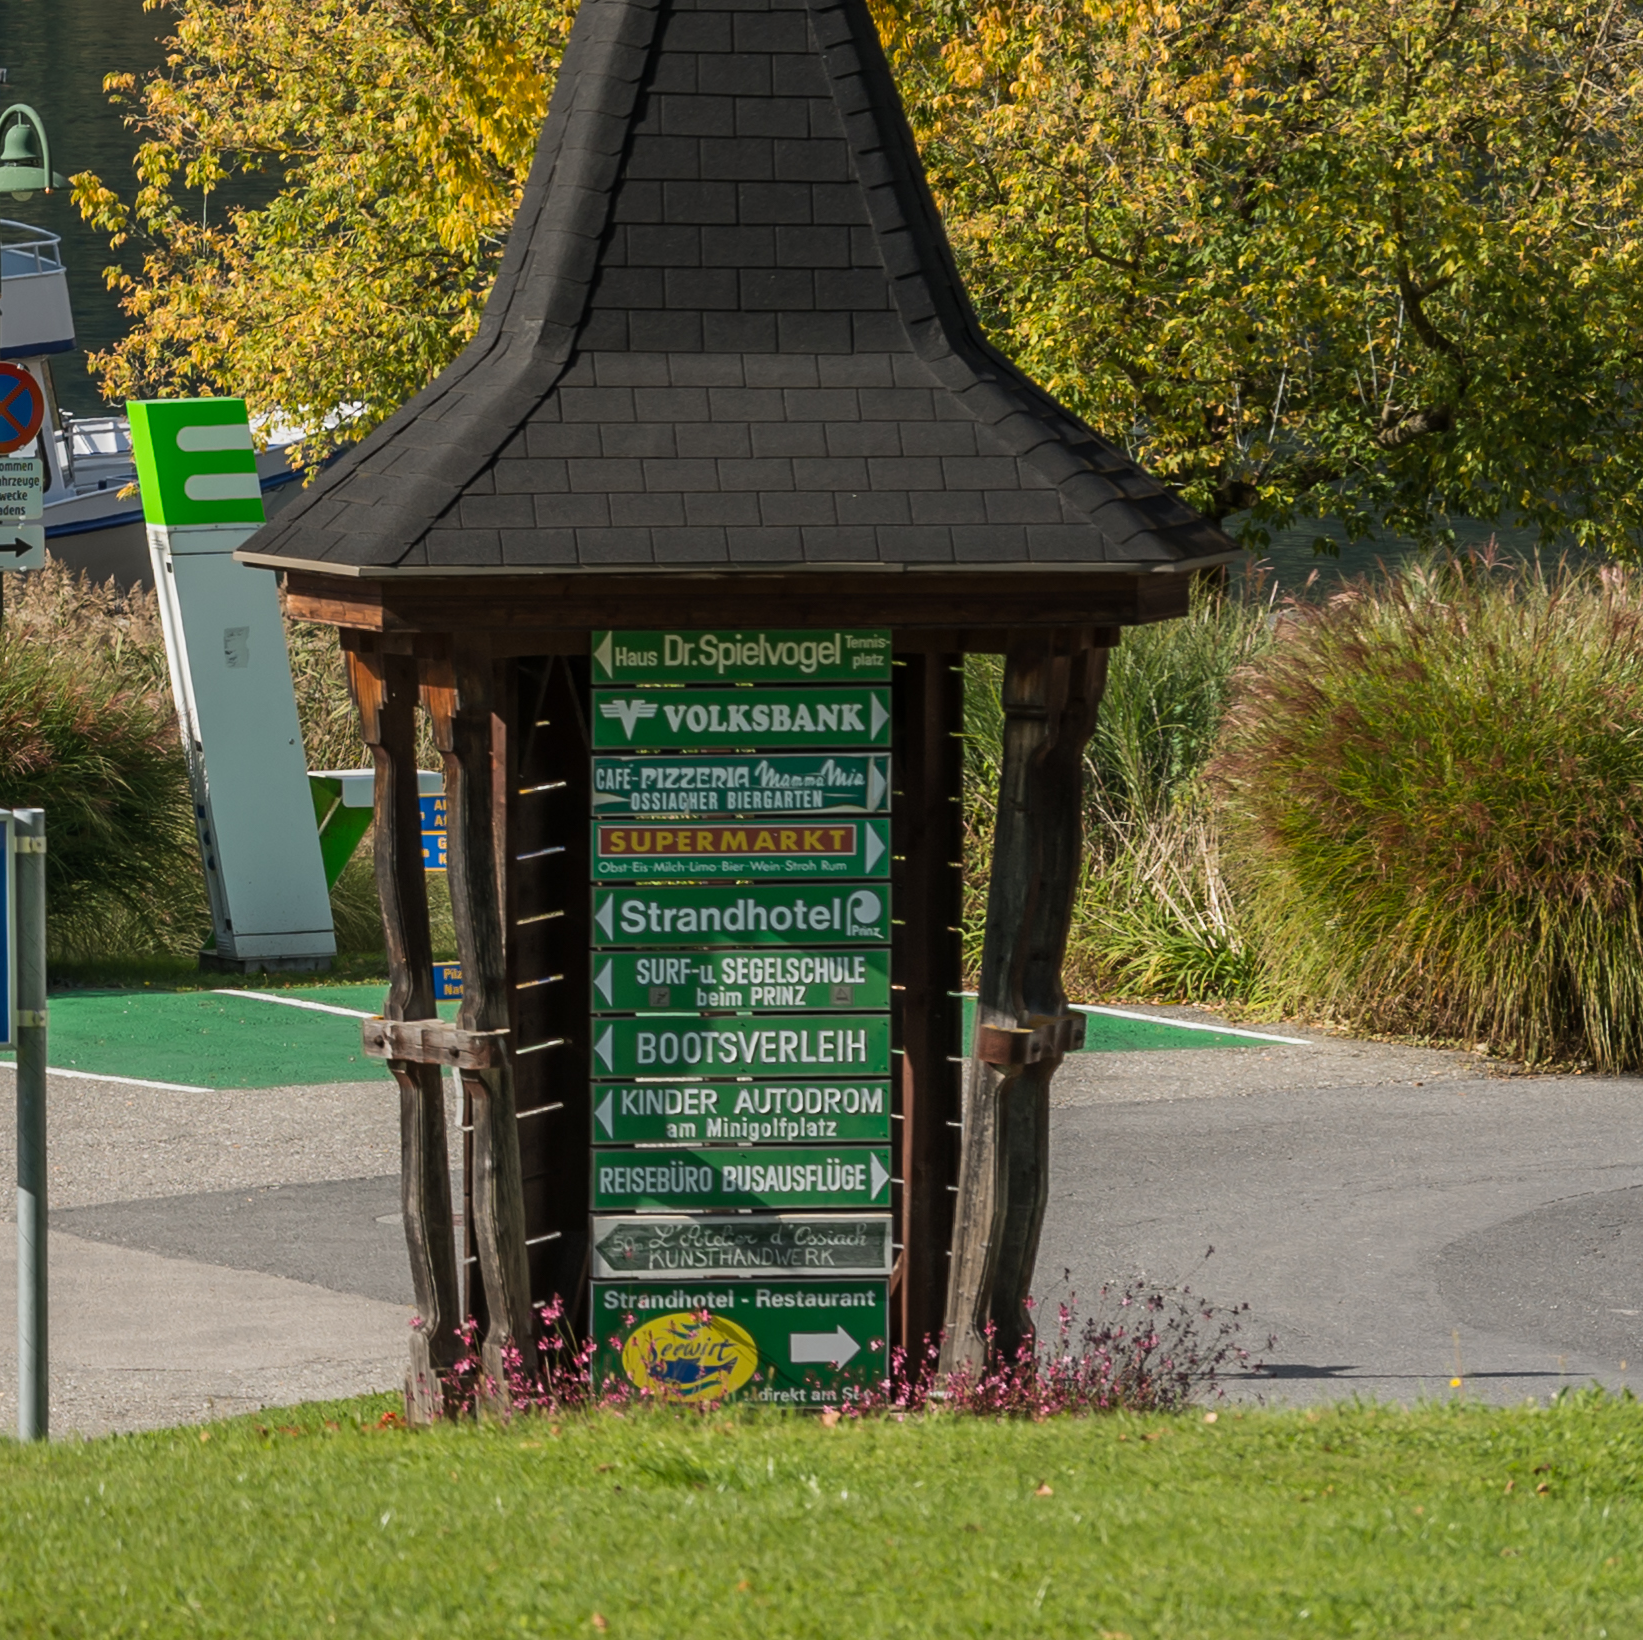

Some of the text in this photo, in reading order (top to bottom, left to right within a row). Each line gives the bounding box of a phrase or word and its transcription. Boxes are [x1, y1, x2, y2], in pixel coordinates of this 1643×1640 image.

[615, 648, 658, 666] Haus
[845, 634, 891, 650] Tennis-
[852, 652, 885, 669] platz
[663, 704, 865, 733] VOLKSBANK
[755, 760, 825, 788] Mamma
[820, 759, 865, 787] Mia
[630, 790, 823, 811] OSSIACHER BIERGARTEN
[609, 830, 847, 852] SUPERMARKT
[820, 860, 847, 872] Rum
[620, 898, 842, 934] Strandhotel
[851, 925, 884, 938] Prinz
[721, 956, 865, 984] SEGELSCHULE
[696, 986, 807, 1006] beim PRINZ
[636, 1029, 867, 1064] BOOTSVERLEIH
[620, 1086, 884, 1116] KINDER AUTODROM
[666, 1118, 837, 1141] am Minigolfplatz
[599, 1160, 866, 1193] REISEBÜRO BUSAUSFLÜGE
[649, 1246, 835, 1270] KUNSTHANDWERK
[603, 1290, 734, 1310] Strandhotel
[756, 1288, 876, 1308] Restaurant
[648, 1336, 737, 1362] Seewirt
[811, 1390, 837, 1402] am
